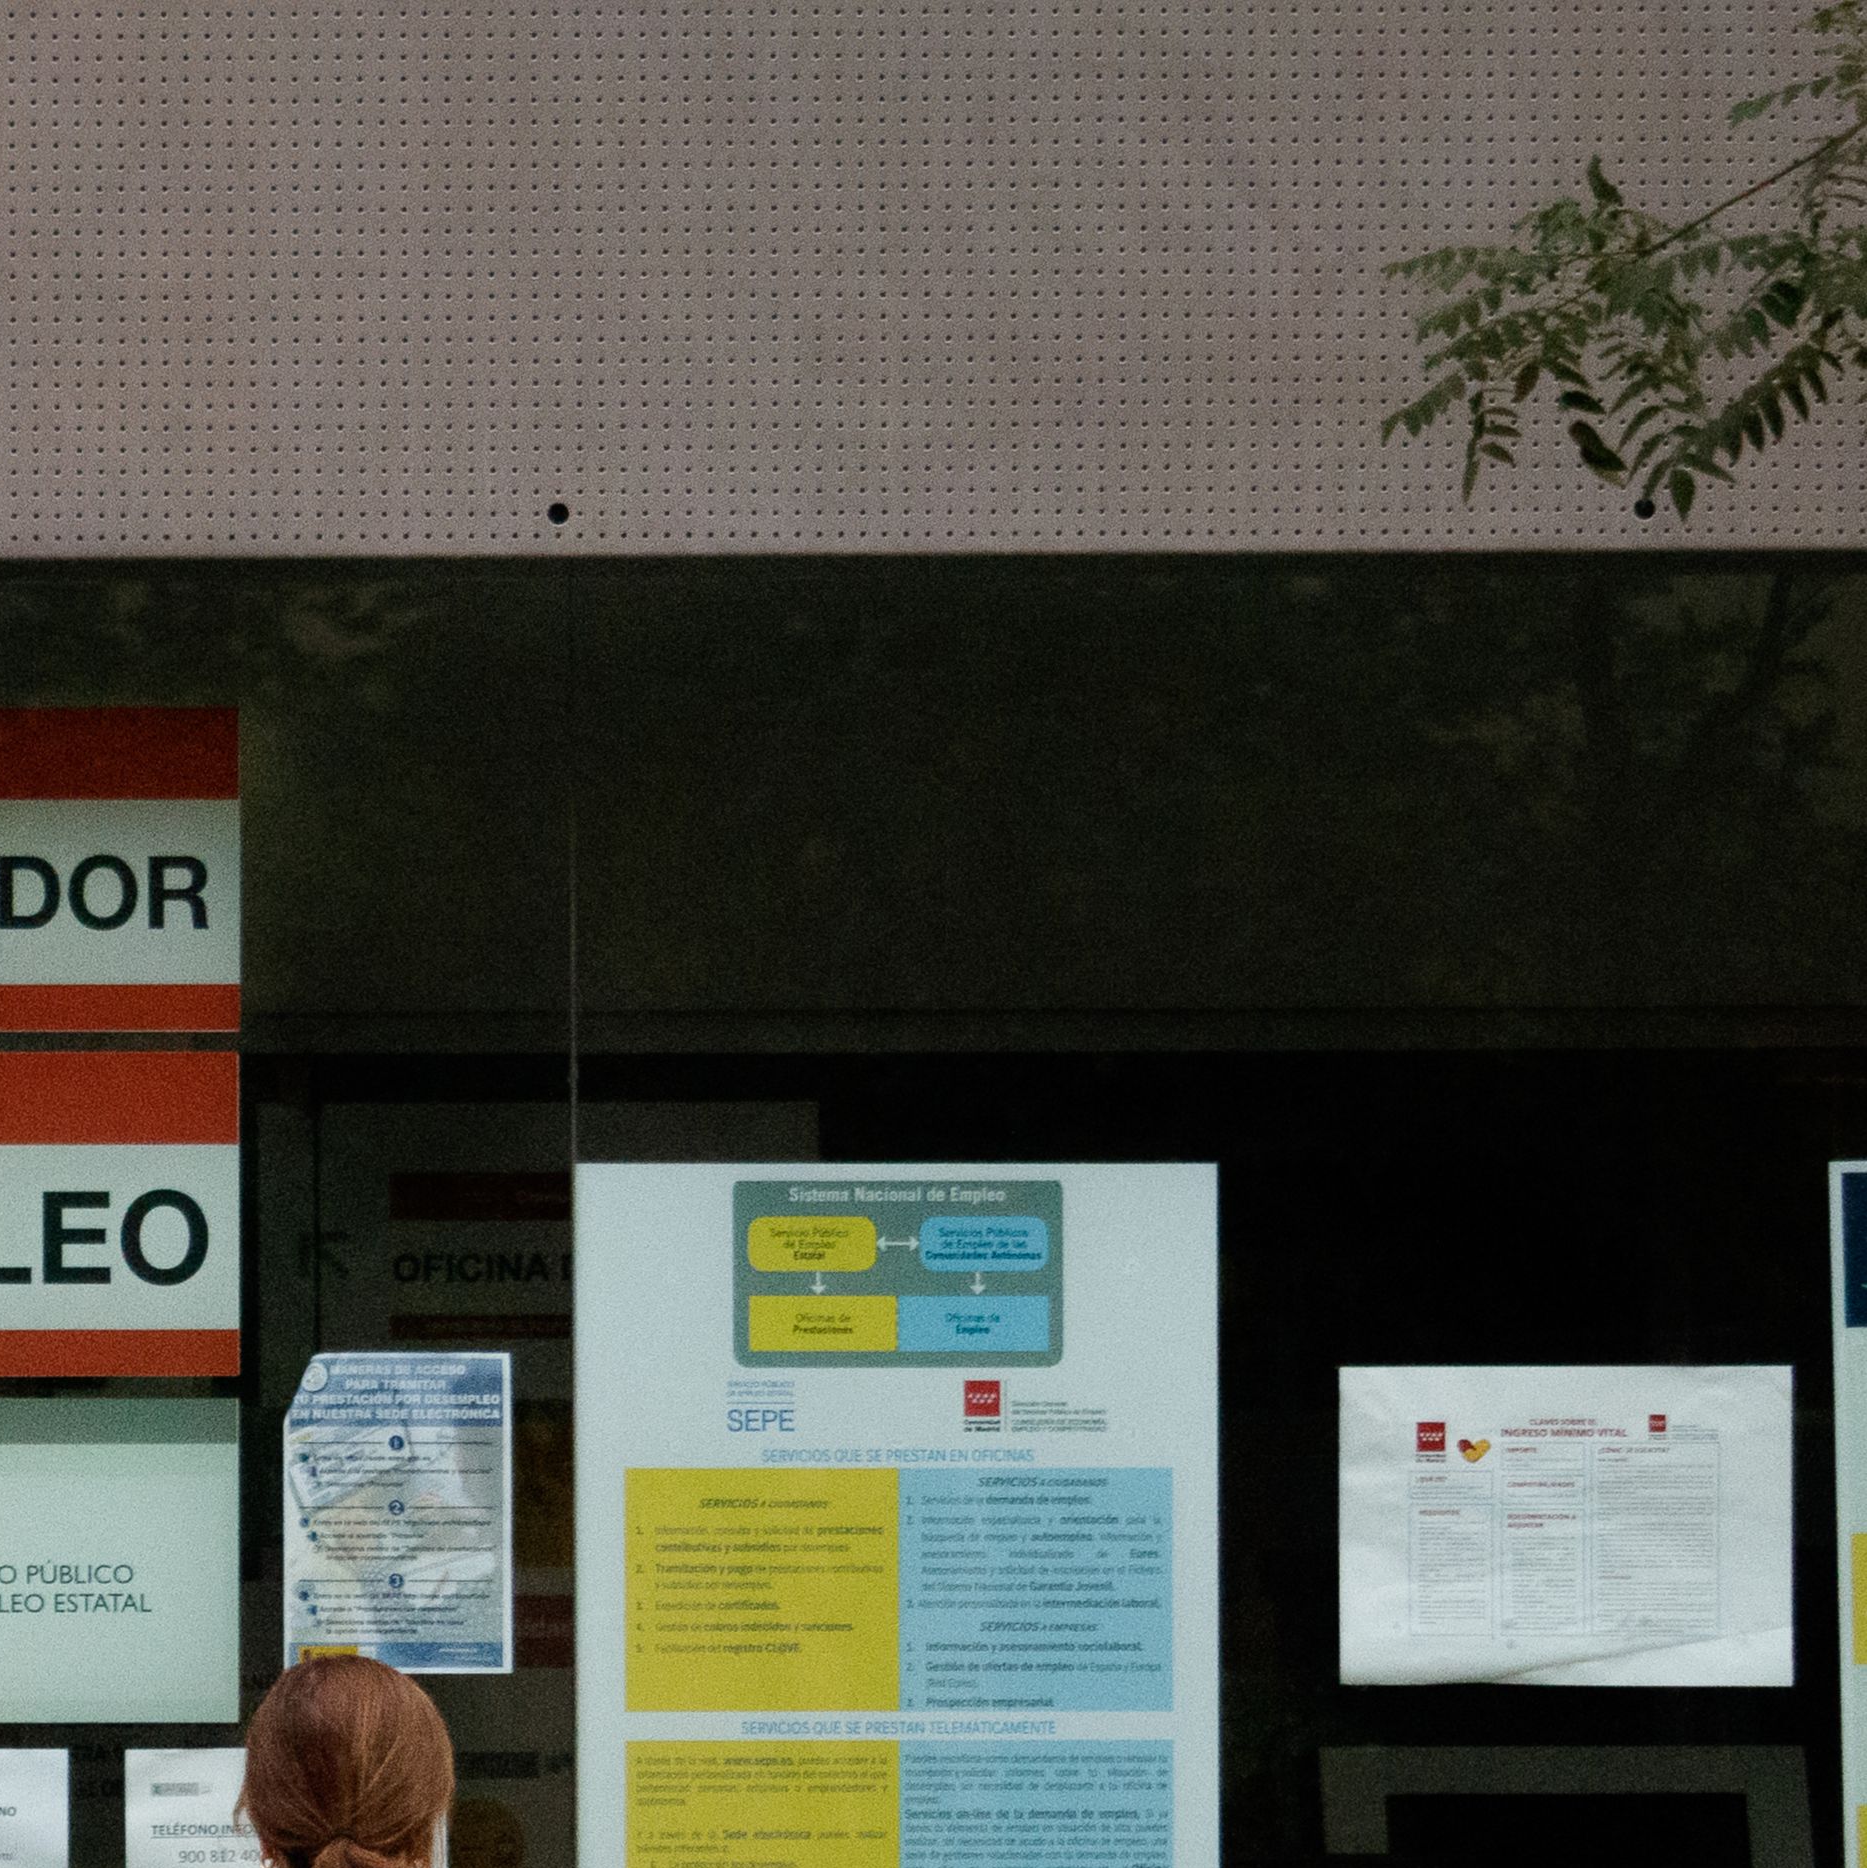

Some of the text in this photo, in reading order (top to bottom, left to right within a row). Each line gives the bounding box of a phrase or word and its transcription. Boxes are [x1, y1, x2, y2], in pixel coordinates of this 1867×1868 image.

[789, 1187, 1006, 1204] Sistema Nacional de Empleo
[728, 1409, 794, 1432] SEPE
[1501, 1429, 1548, 1437] INGRESO
[1598, 1429, 1627, 1437] VITAL
[762, 1449, 1035, 1462] SERVICIOS QUE SE PRESTAN EN OFICINAS
[26, 1564, 134, 1584] PÚBLICO
[54, 1593, 151, 1613] ESTATAL
[742, 1721, 810, 1734] SERVICIOS
[813, 1721, 840, 1735] QUE
[845, 1721, 861, 1734] SE
[865, 1721, 926, 1734] PRESTAN
[151, 1822, 218, 1836] TELÉFONO
[177, 1850, 206, 1863] 900
[209, 1850, 236, 1863] 812
